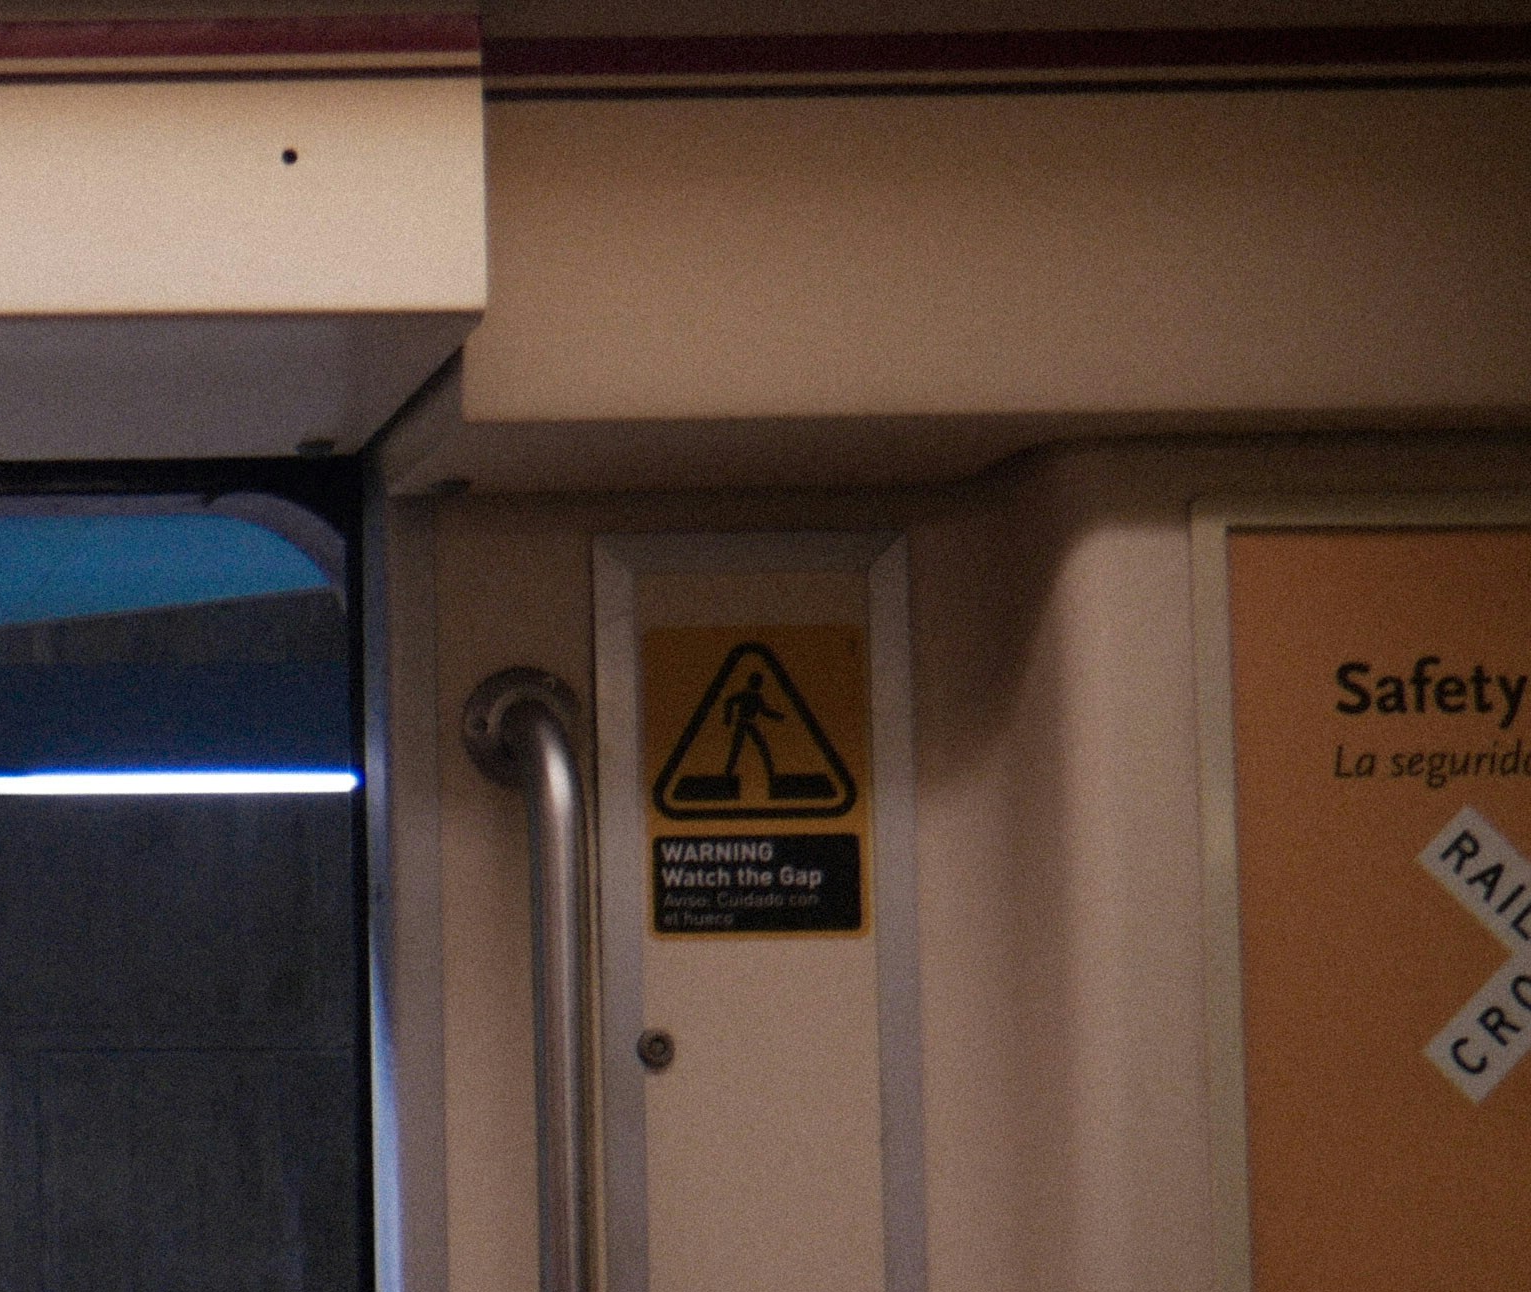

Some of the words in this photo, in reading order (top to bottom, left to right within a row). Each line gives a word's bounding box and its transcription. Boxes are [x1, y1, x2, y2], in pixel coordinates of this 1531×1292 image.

[1335, 656, 1528, 730] Safety
[1334, 744, 1376, 779] La
[660, 842, 773, 863] WARNING
[661, 867, 730, 888] Watch
[737, 867, 773, 888] the
[779, 865, 823, 890] Gap
